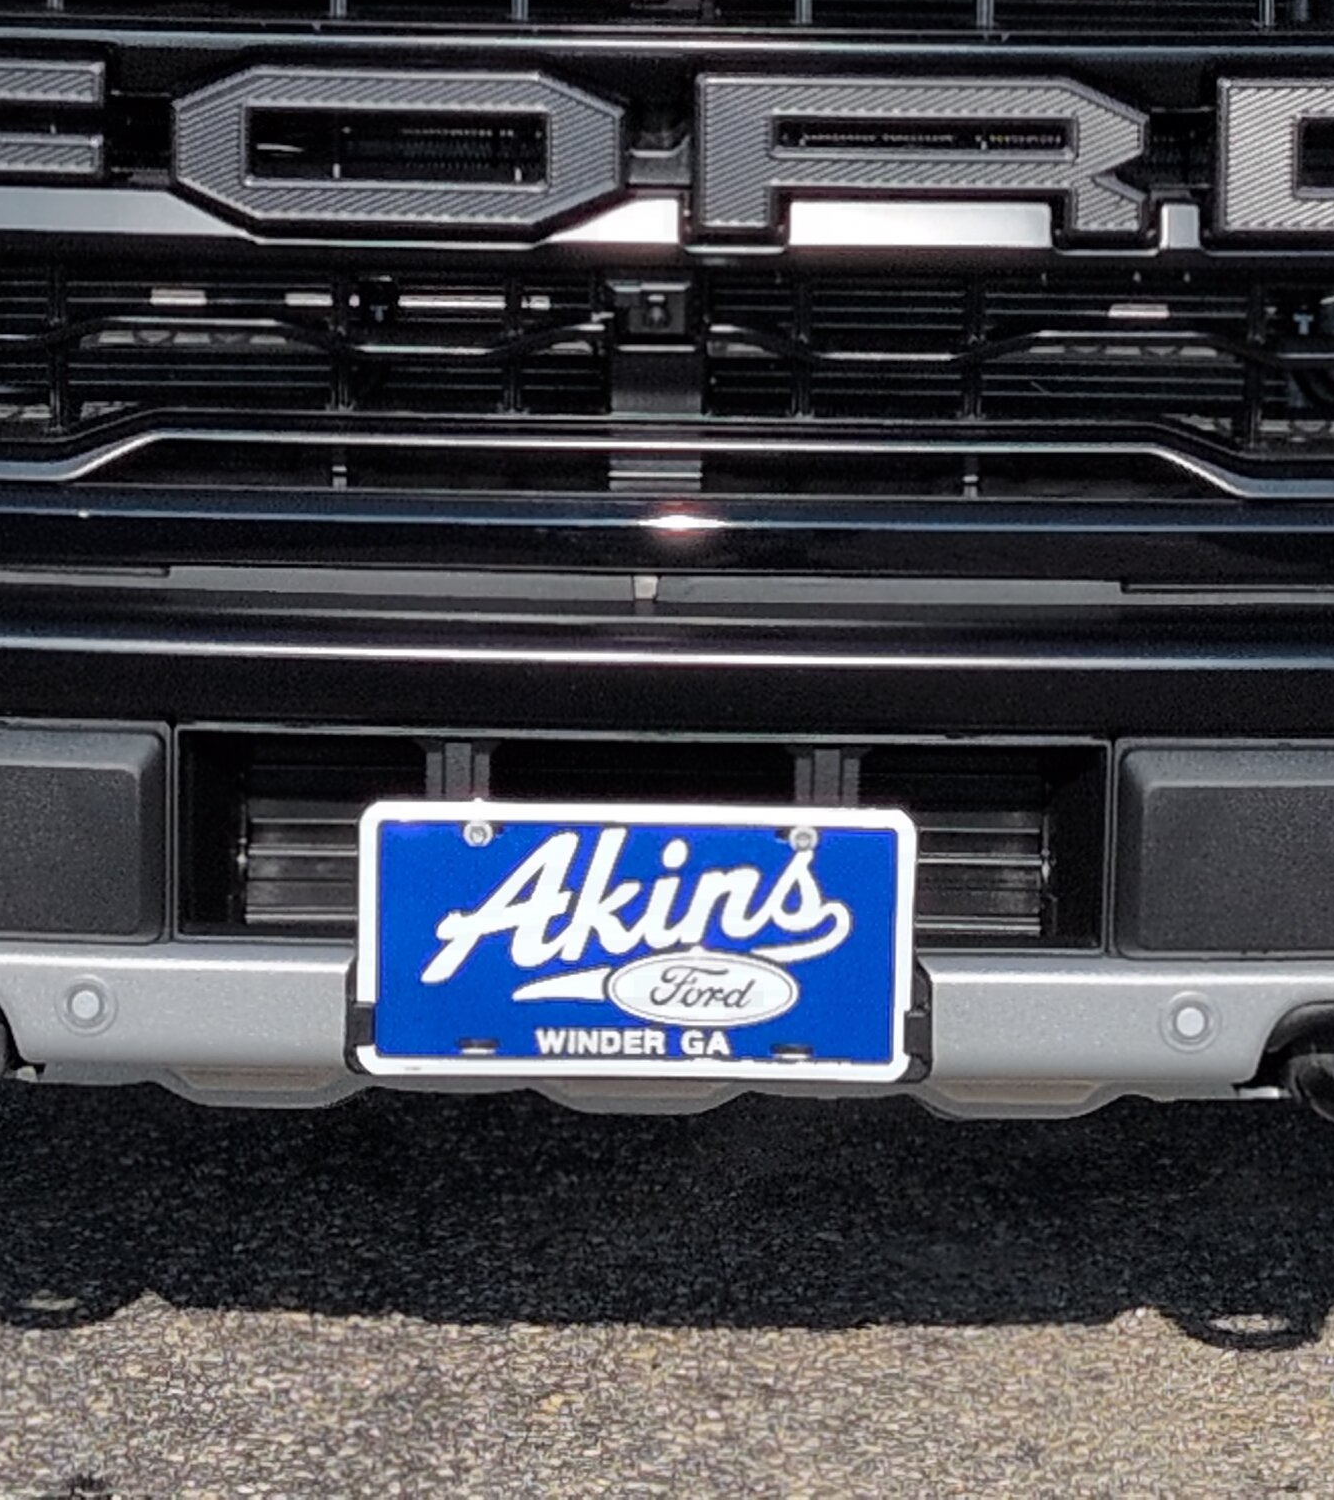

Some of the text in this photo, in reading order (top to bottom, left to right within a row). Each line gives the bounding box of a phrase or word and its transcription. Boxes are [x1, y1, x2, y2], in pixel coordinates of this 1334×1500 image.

[419, 827, 852, 984] Akins
[649, 966, 753, 1010] Ford
[534, 1028, 732, 1057] WINDER GA
